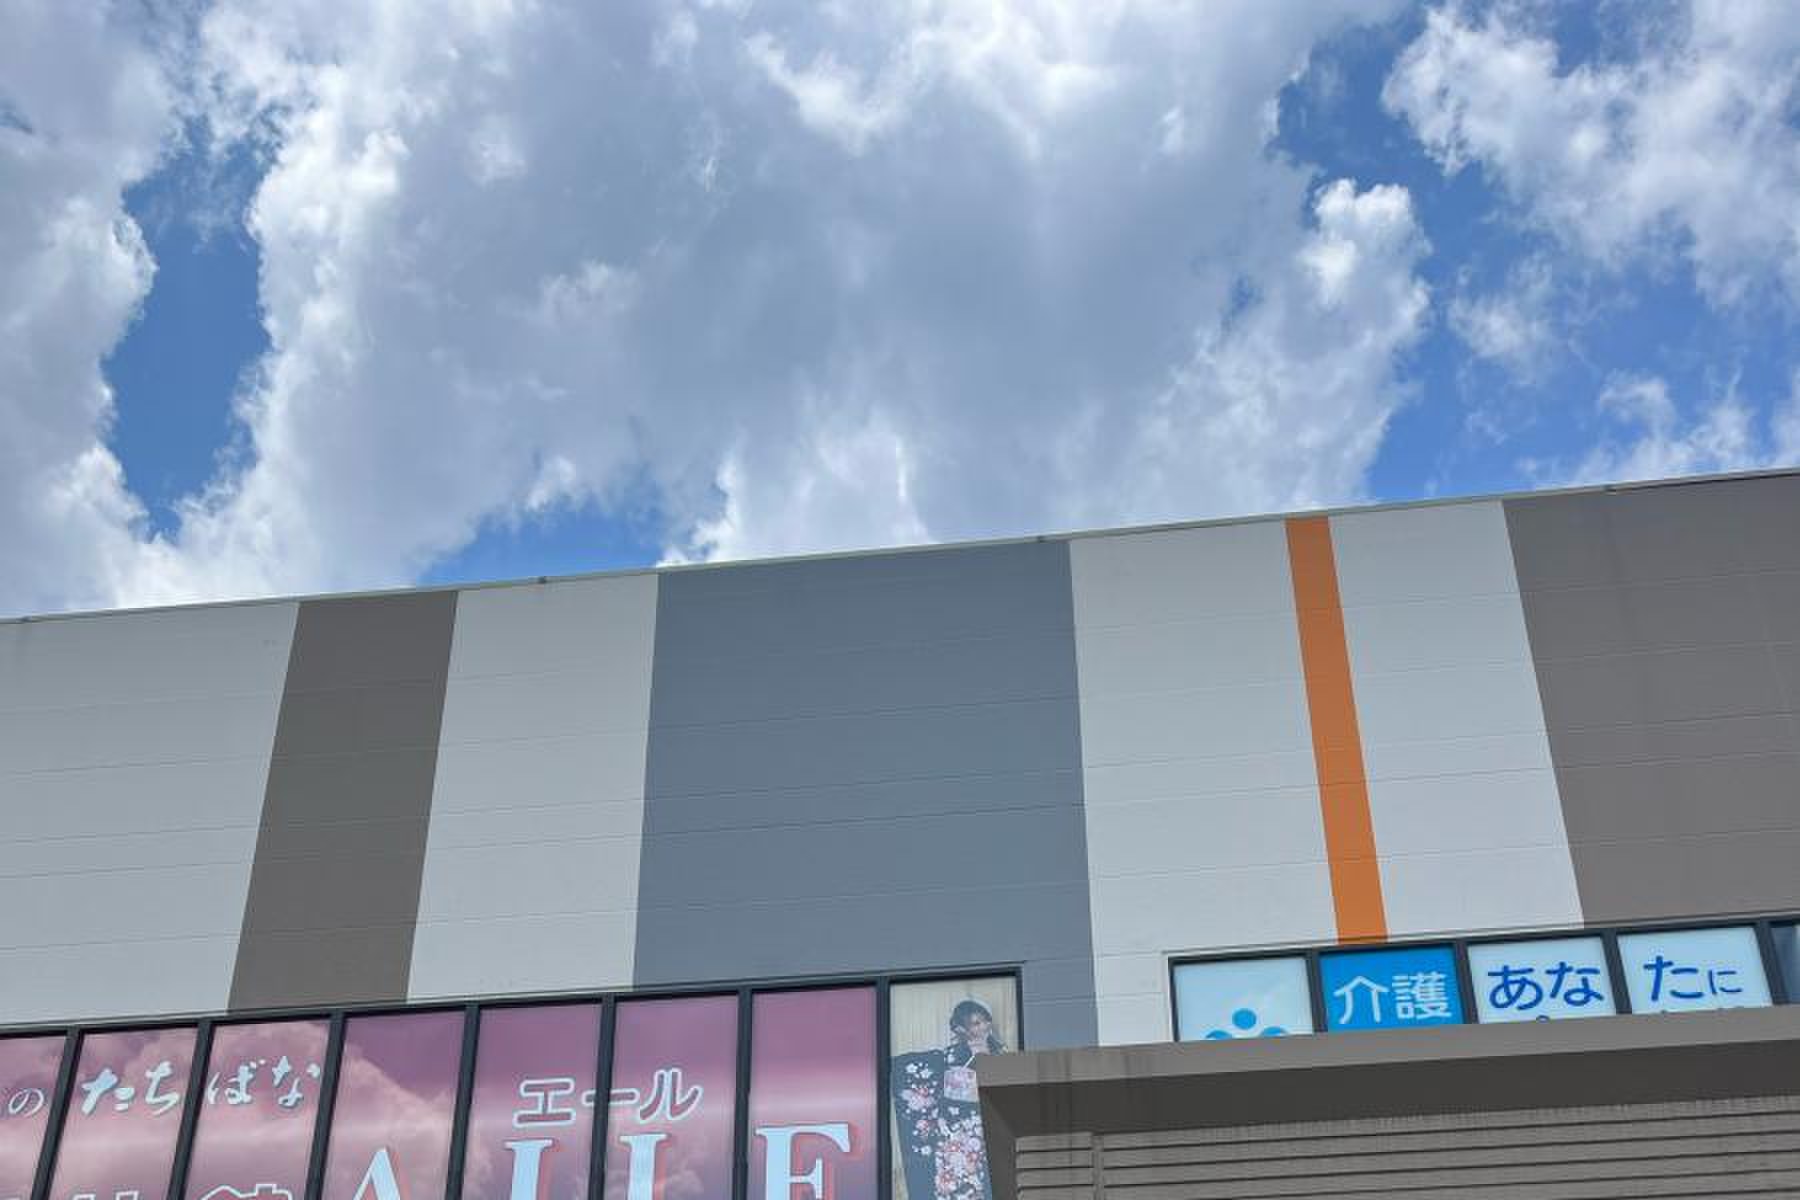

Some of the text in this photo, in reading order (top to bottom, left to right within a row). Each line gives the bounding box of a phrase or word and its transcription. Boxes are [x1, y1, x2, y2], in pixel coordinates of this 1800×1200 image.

[1333, 971, 1452, 1025] 介護
[1488, 955, 1742, 1011] あなたに
[513, 1066, 703, 1127] エール
